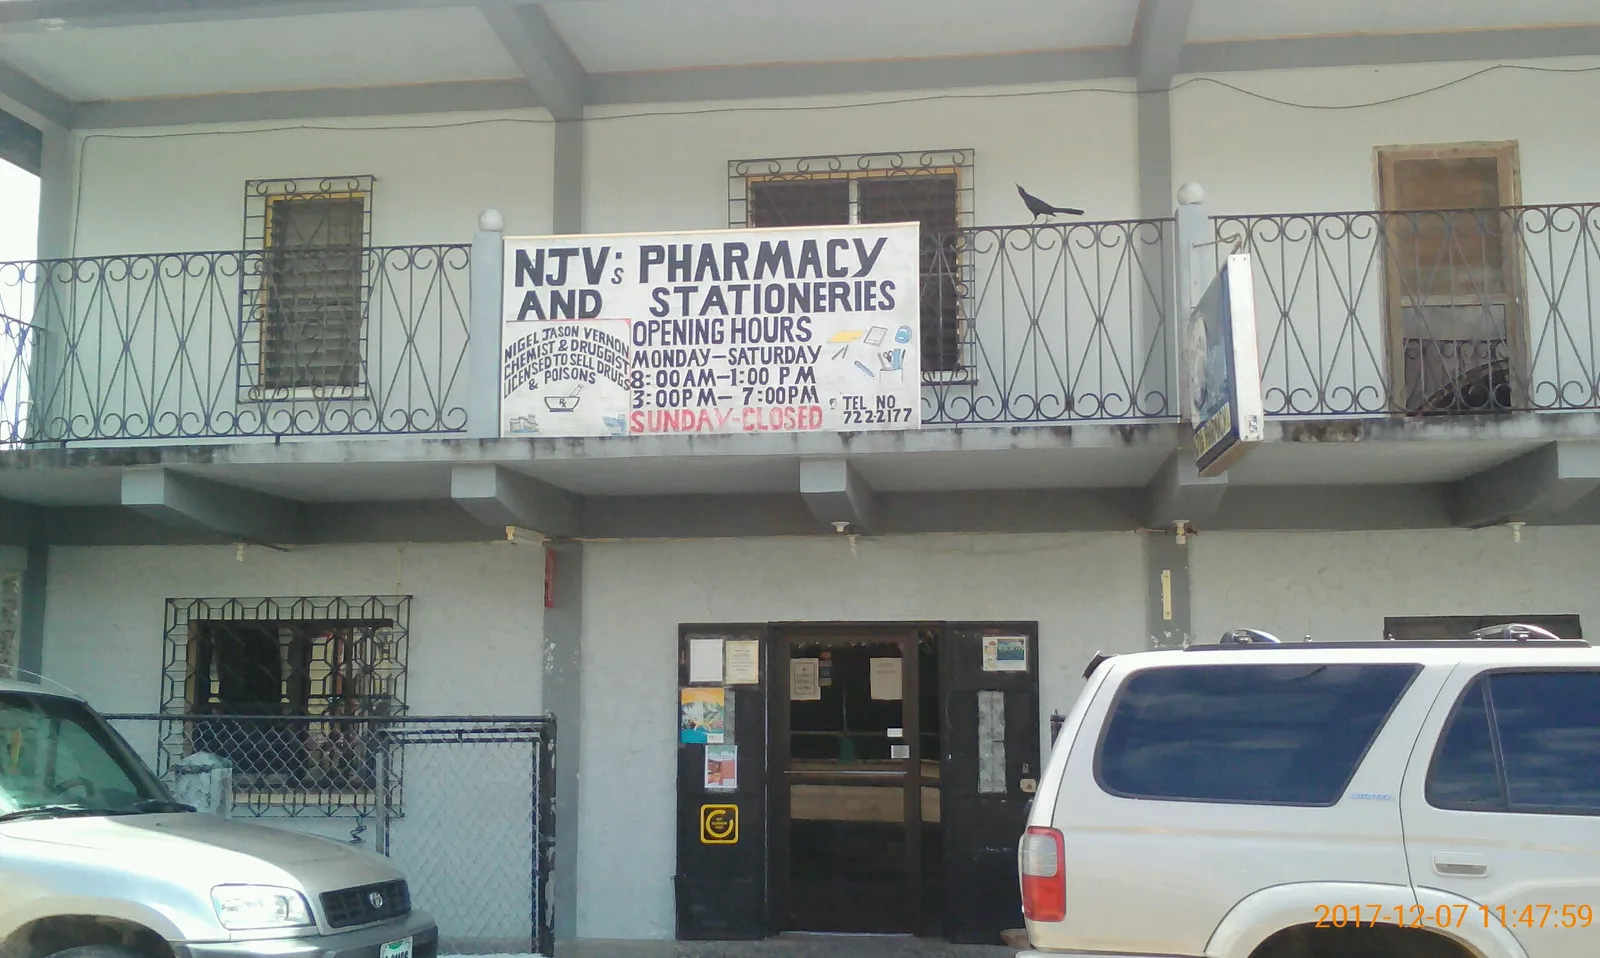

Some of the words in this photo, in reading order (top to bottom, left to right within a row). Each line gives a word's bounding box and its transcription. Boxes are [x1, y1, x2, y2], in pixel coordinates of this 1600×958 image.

[639, 237, 889, 284] PHARMACY
[517, 289, 603, 320] AND
[649, 280, 896, 317] STATIONERIES
[505, 332, 539, 363] NIGEL
[542, 326, 580, 341] JASON
[584, 327, 630, 359] VERNON
[632, 318, 725, 346] OPENING
[731, 316, 812, 344] HOURS
[503, 356, 552, 400] LICENSED
[553, 353, 568, 366] TO
[570, 353, 595, 370] SELL
[597, 360, 632, 391] DRUGS
[504, 341, 556, 380] CHEMIST
[558, 339, 569, 352] &
[571, 339, 631, 375] DRUGGIST
[528, 378, 539, 391] &
[544, 367, 596, 385] POISONS
[843, 395, 867, 410] TEL
[876, 394, 896, 409] NO
